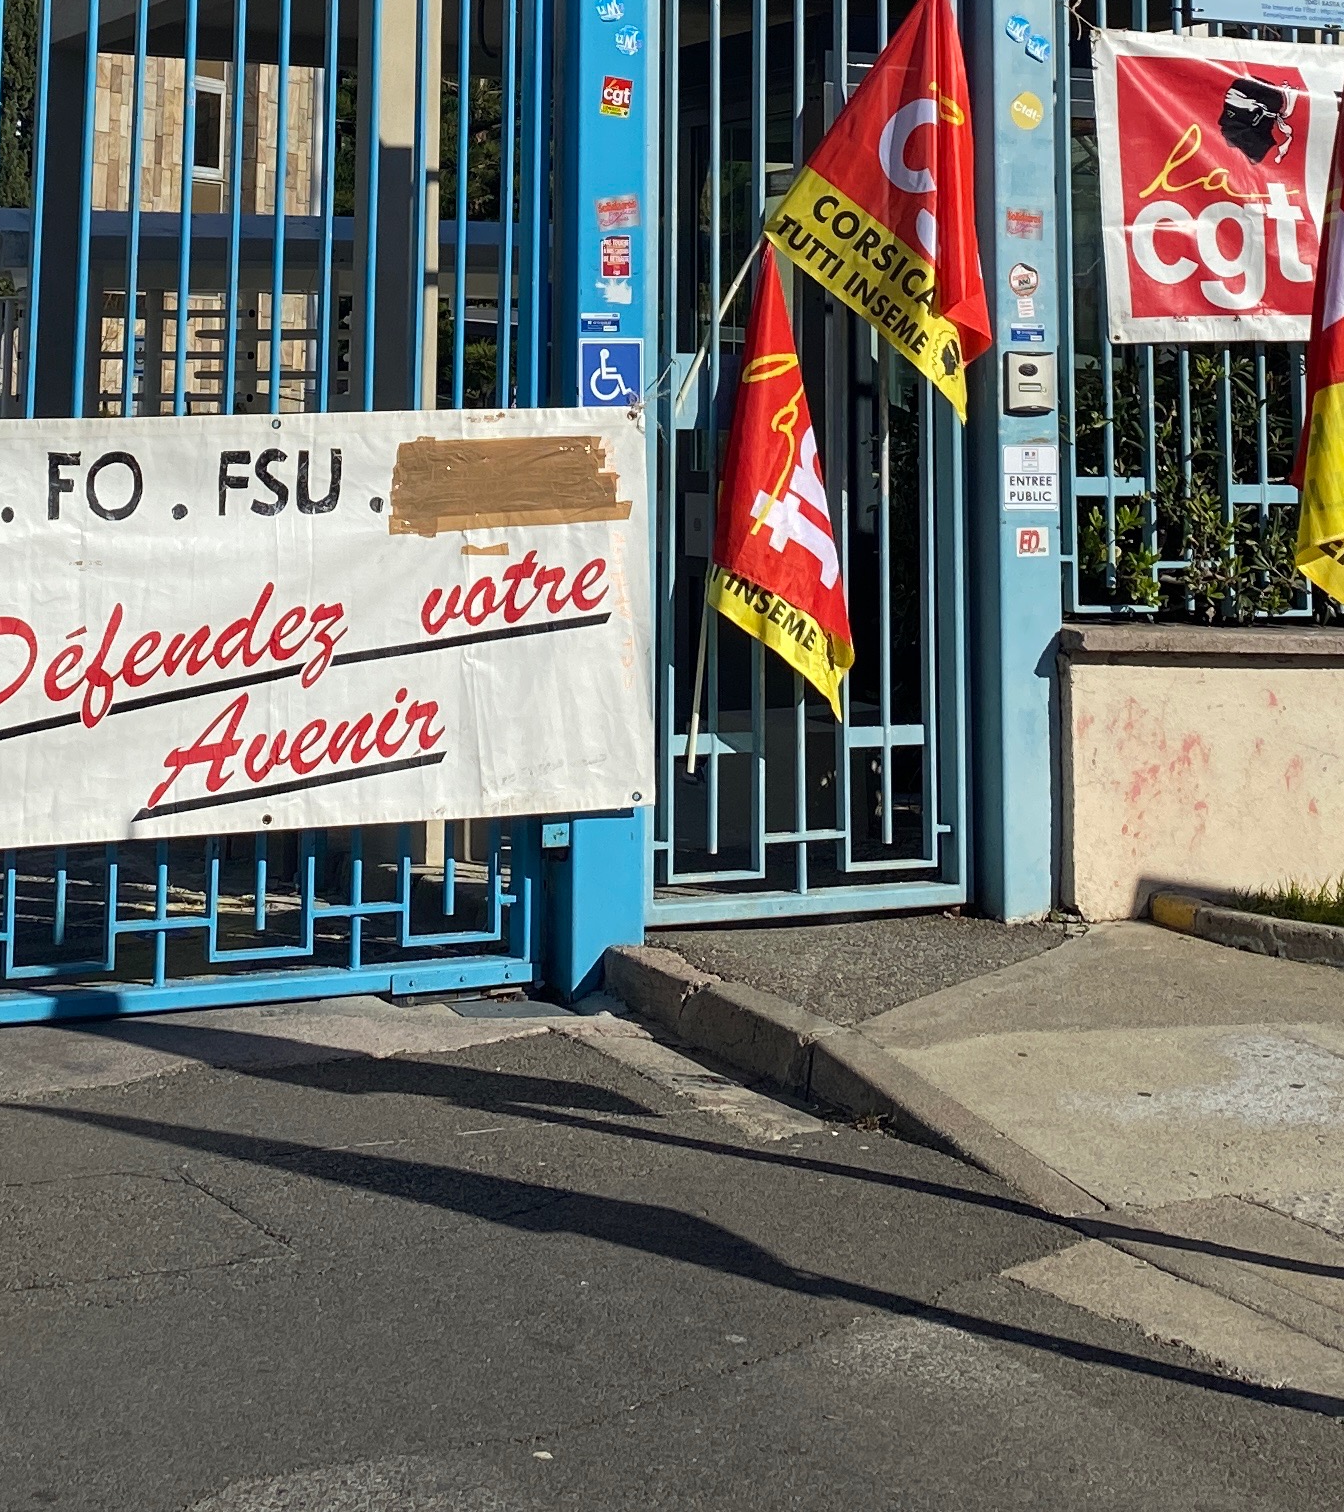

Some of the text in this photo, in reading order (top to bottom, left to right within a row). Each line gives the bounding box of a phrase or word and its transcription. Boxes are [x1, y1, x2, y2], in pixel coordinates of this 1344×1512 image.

[603, 87, 632, 106] cgt
[775, 213, 930, 357] TUTTI INSEME
[812, 194, 943, 319] CORSICA
[1131, 181, 1314, 310] cgt
[47, 450, 145, 522] FO
[218, 447, 344, 517] FSU
[1009, 475, 1053, 487] ENTREE
[1009, 491, 1053, 502] PUBLIC
[420, 550, 610, 637] votre
[725, 574, 817, 652] INSEME
[147, 686, 448, 811] Avenir
